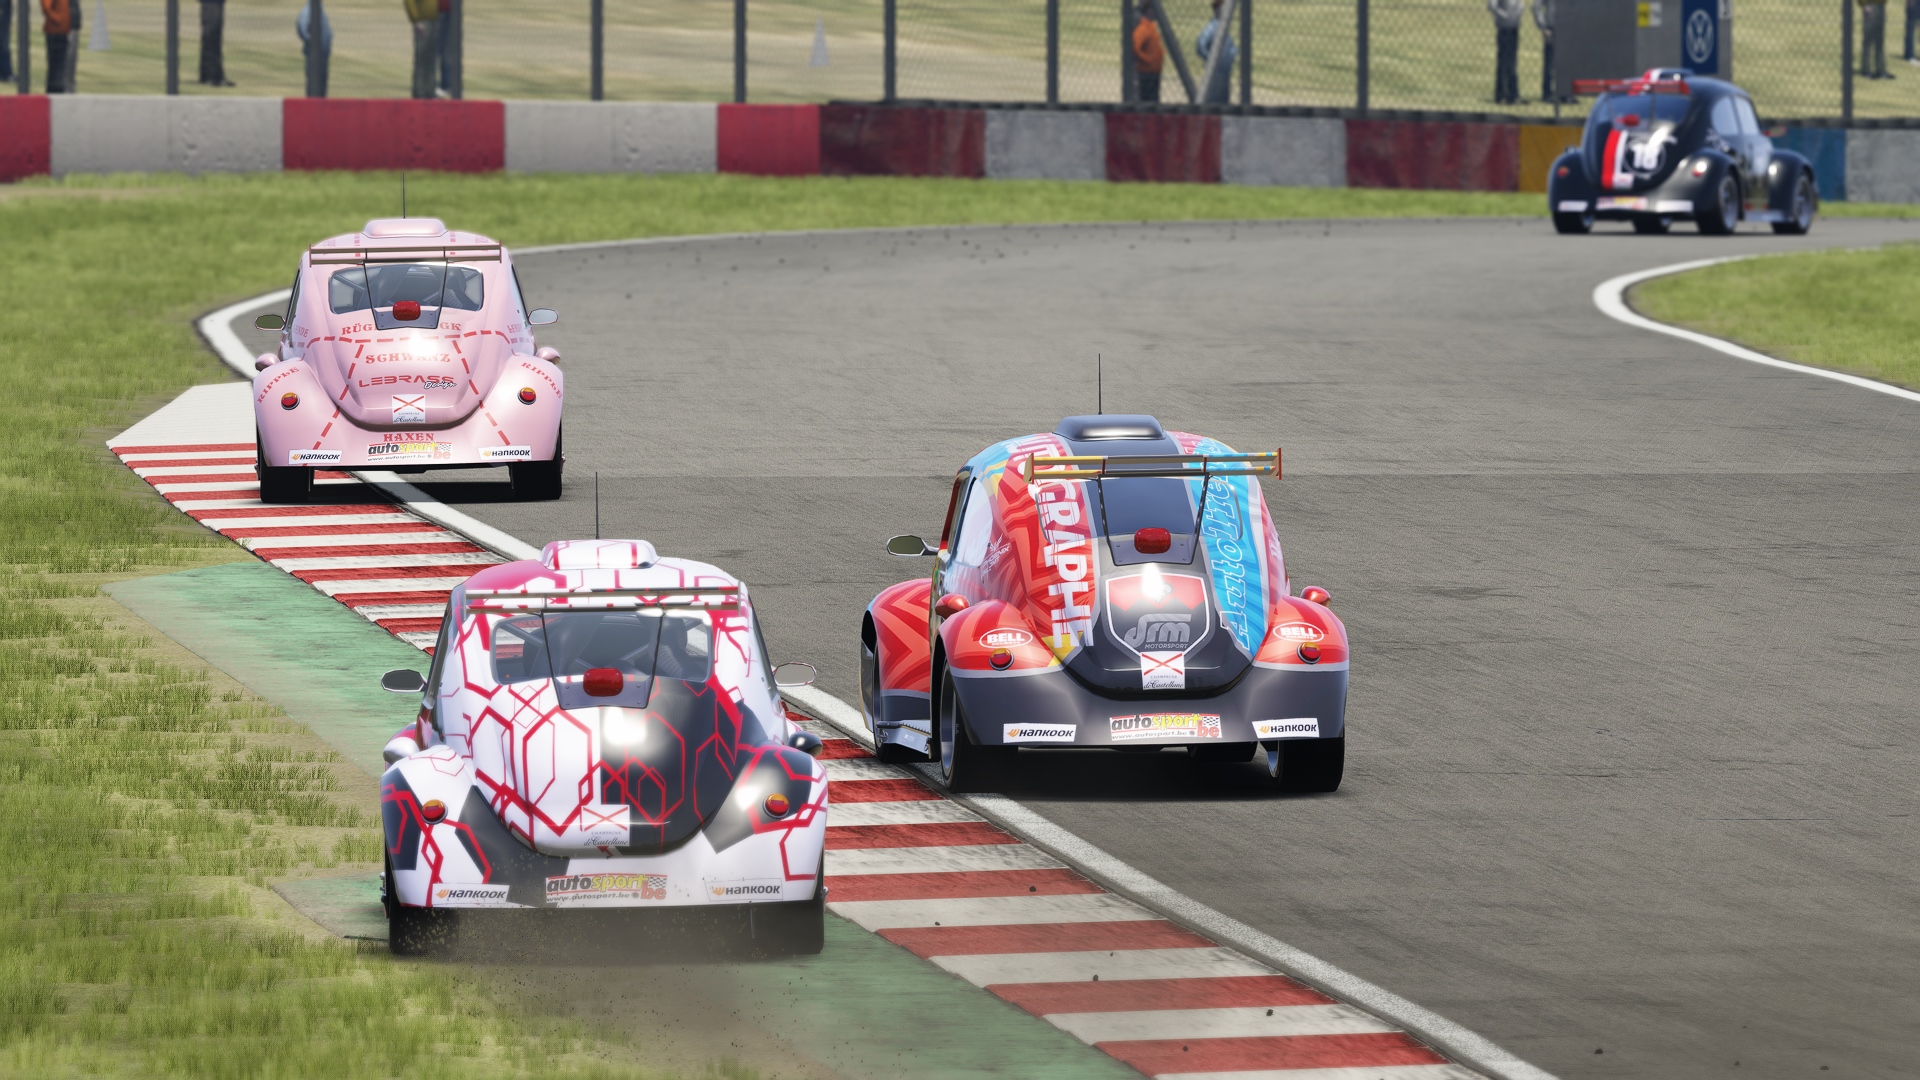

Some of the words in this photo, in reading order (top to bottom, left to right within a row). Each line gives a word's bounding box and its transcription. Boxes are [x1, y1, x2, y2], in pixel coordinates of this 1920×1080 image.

[383, 432, 434, 442] HAXEN
[368, 441, 438, 454] autosport
[1280, 626, 1317, 638] BELL
[987, 633, 1025, 644] BELL
[1112, 713, 1202, 730] autosport
[1112, 730, 1187, 739] www.autosport.be
[1197, 721, 1220, 738] be
[547, 873, 648, 892] autosport
[641, 881, 666, 900] be
[547, 892, 629, 902] www.autosport.be
